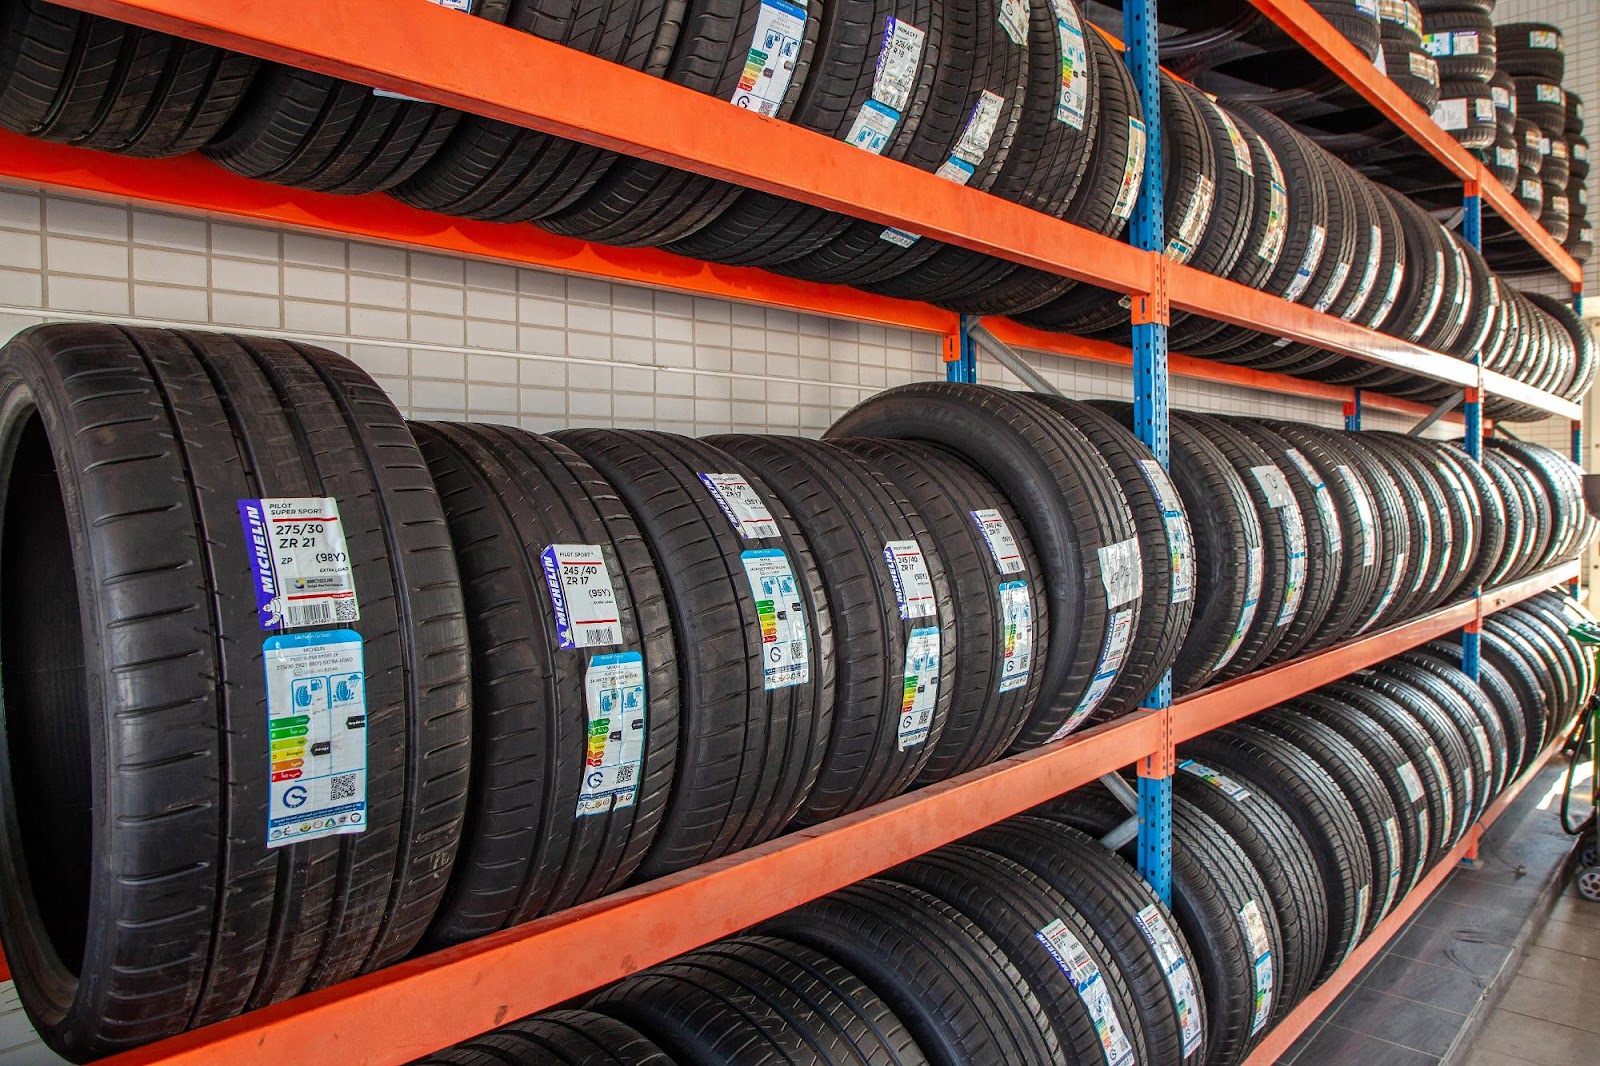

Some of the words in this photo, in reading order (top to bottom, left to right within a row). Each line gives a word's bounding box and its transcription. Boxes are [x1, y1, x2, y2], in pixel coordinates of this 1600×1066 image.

[275, 523, 324, 535] 275/30
[279, 538, 298, 549] ZR
[302, 537, 315, 548] 21
[247, 505, 275, 594] MICHELIN
[281, 557, 293, 565] ZP
[315, 552, 346, 563] (98Y)
[566, 577, 578, 585] ZR
[580, 577, 589, 585] 17
[885, 550, 904, 602] MICHELIN
[543, 556, 567, 626] MICHELIN
[588, 589, 611, 598] (95Y)
